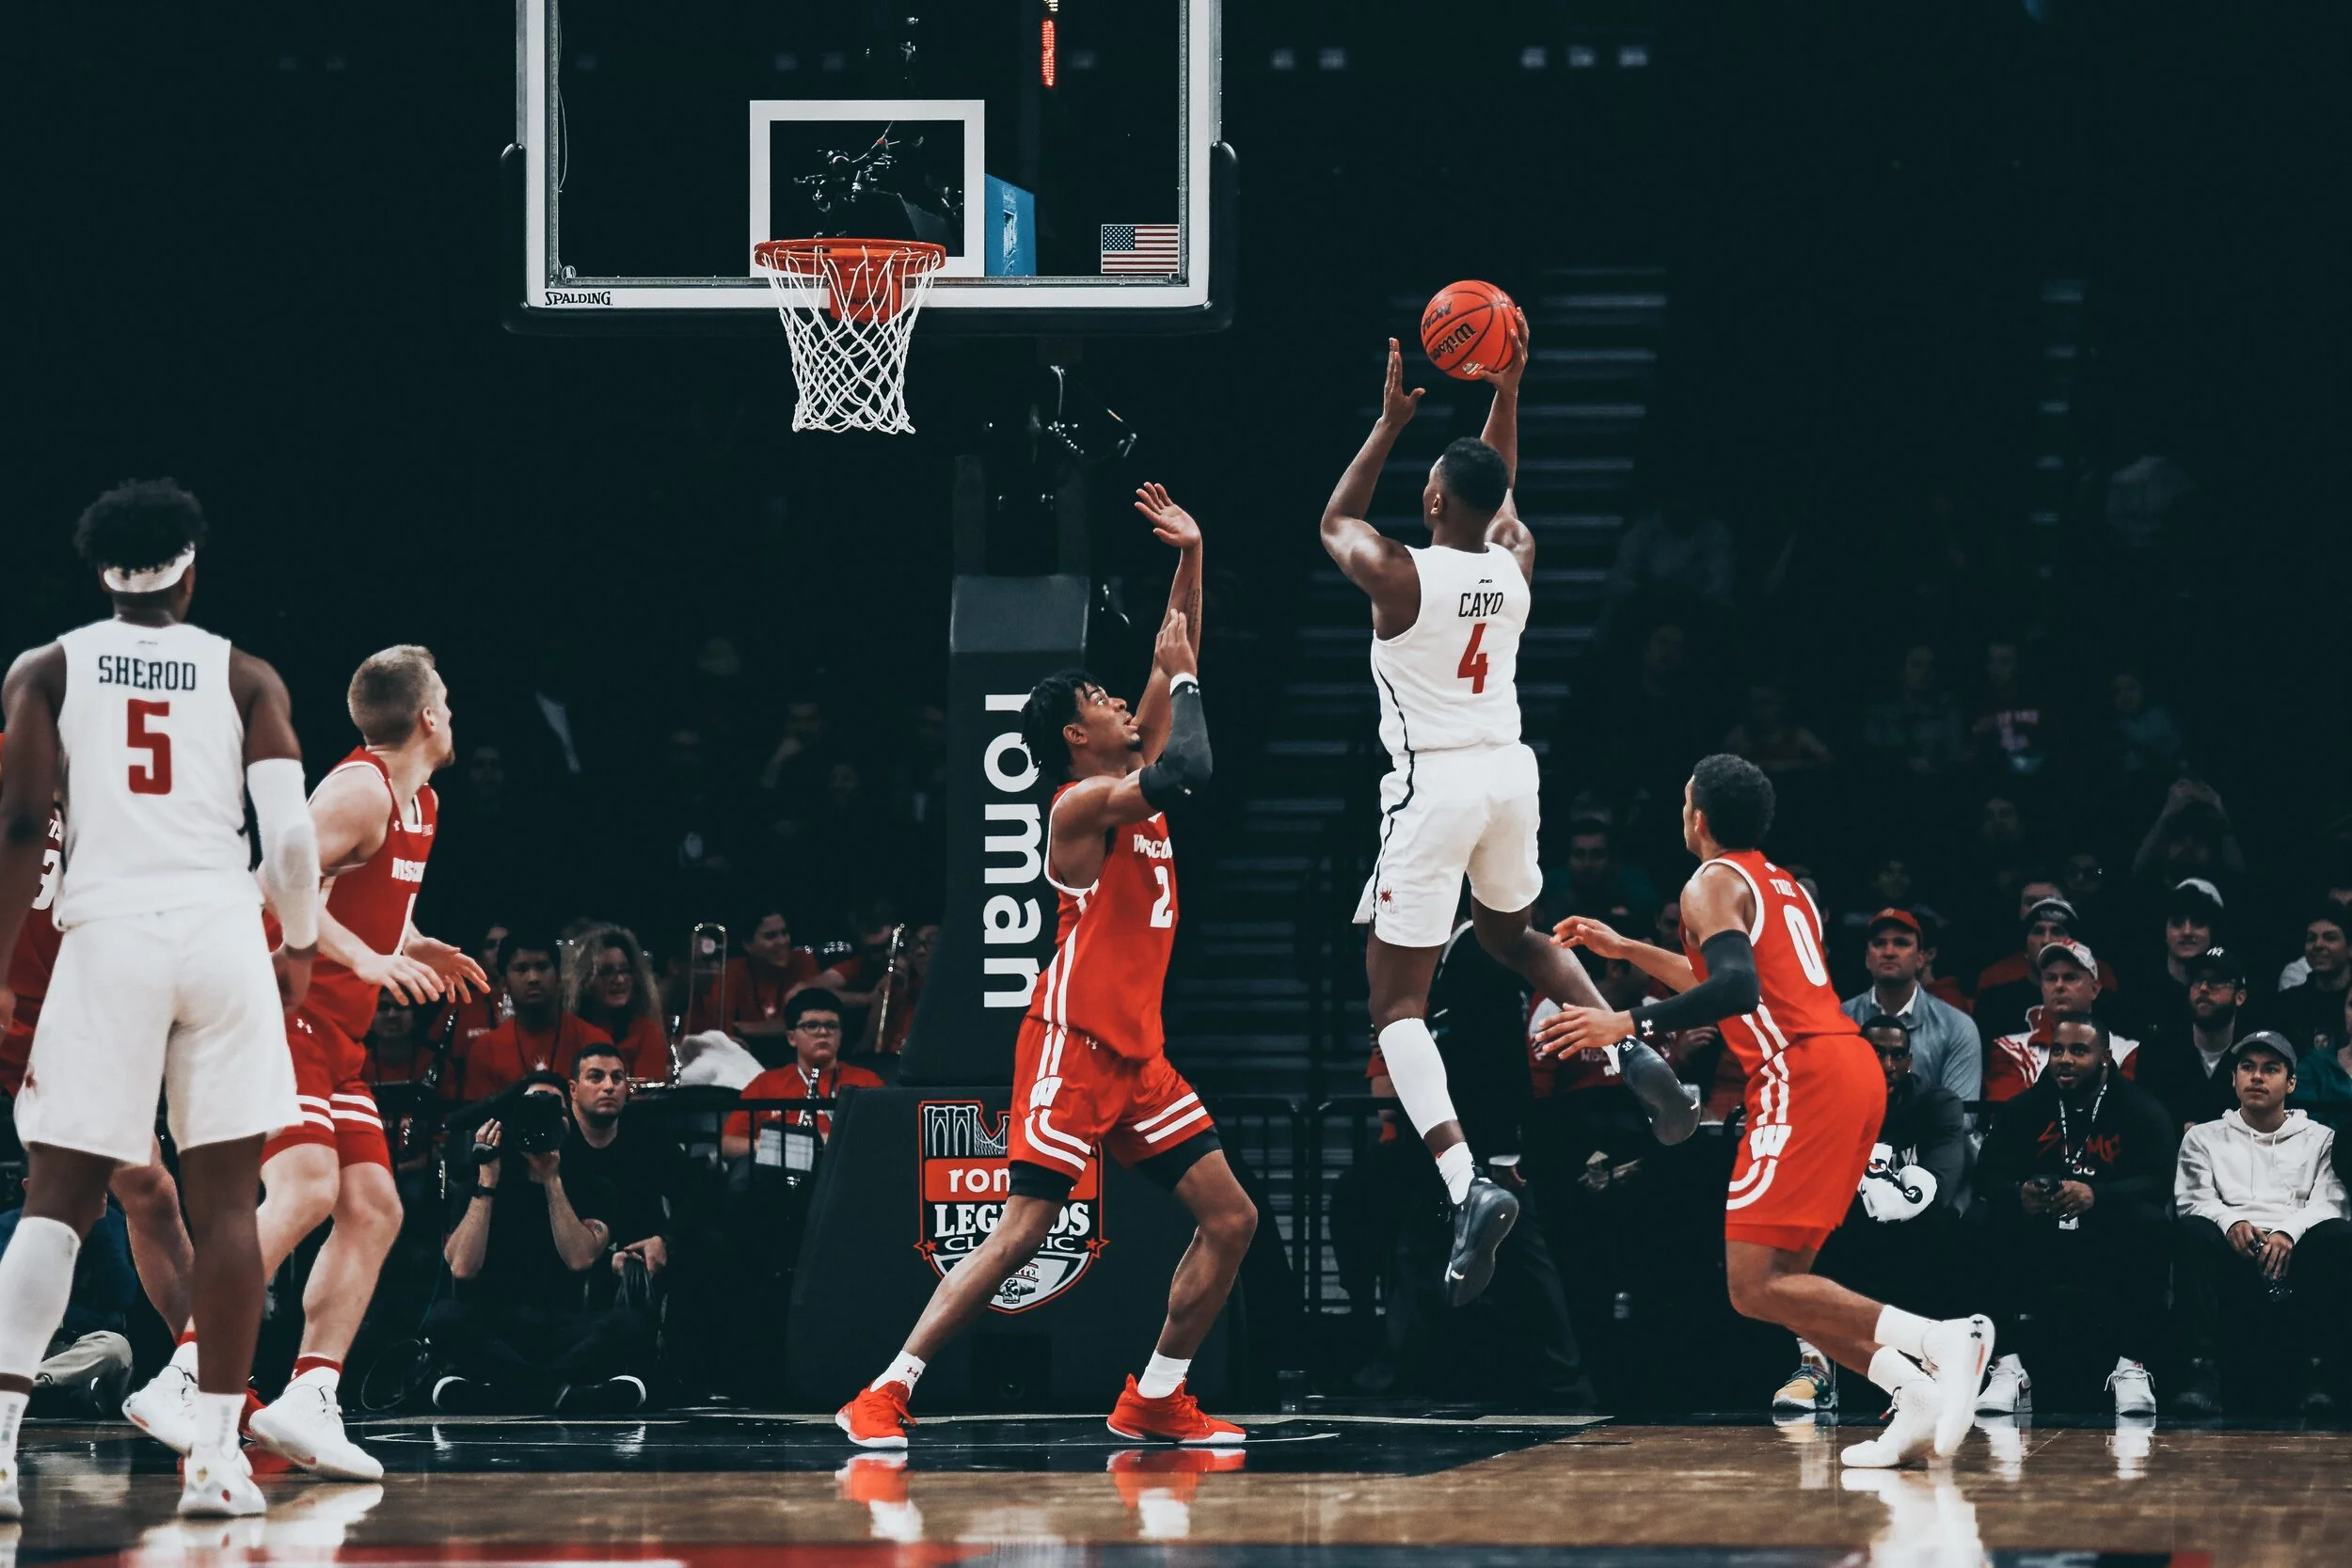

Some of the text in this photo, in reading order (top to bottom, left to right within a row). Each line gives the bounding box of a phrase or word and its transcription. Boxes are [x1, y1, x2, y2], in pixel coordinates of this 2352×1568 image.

[545, 291, 612, 307] SPALDING
[1457, 591, 1504, 618] CAYO
[98, 655, 197, 691] SHEROD
[1456, 622, 1488, 694] 4
[127, 698, 172, 796] 5
[1150, 865, 1174, 928] 2
[1783, 904, 1828, 987] 0
[934, 1202, 1090, 1237] LEGDS
[945, 1237, 1075, 1251] CLIC
